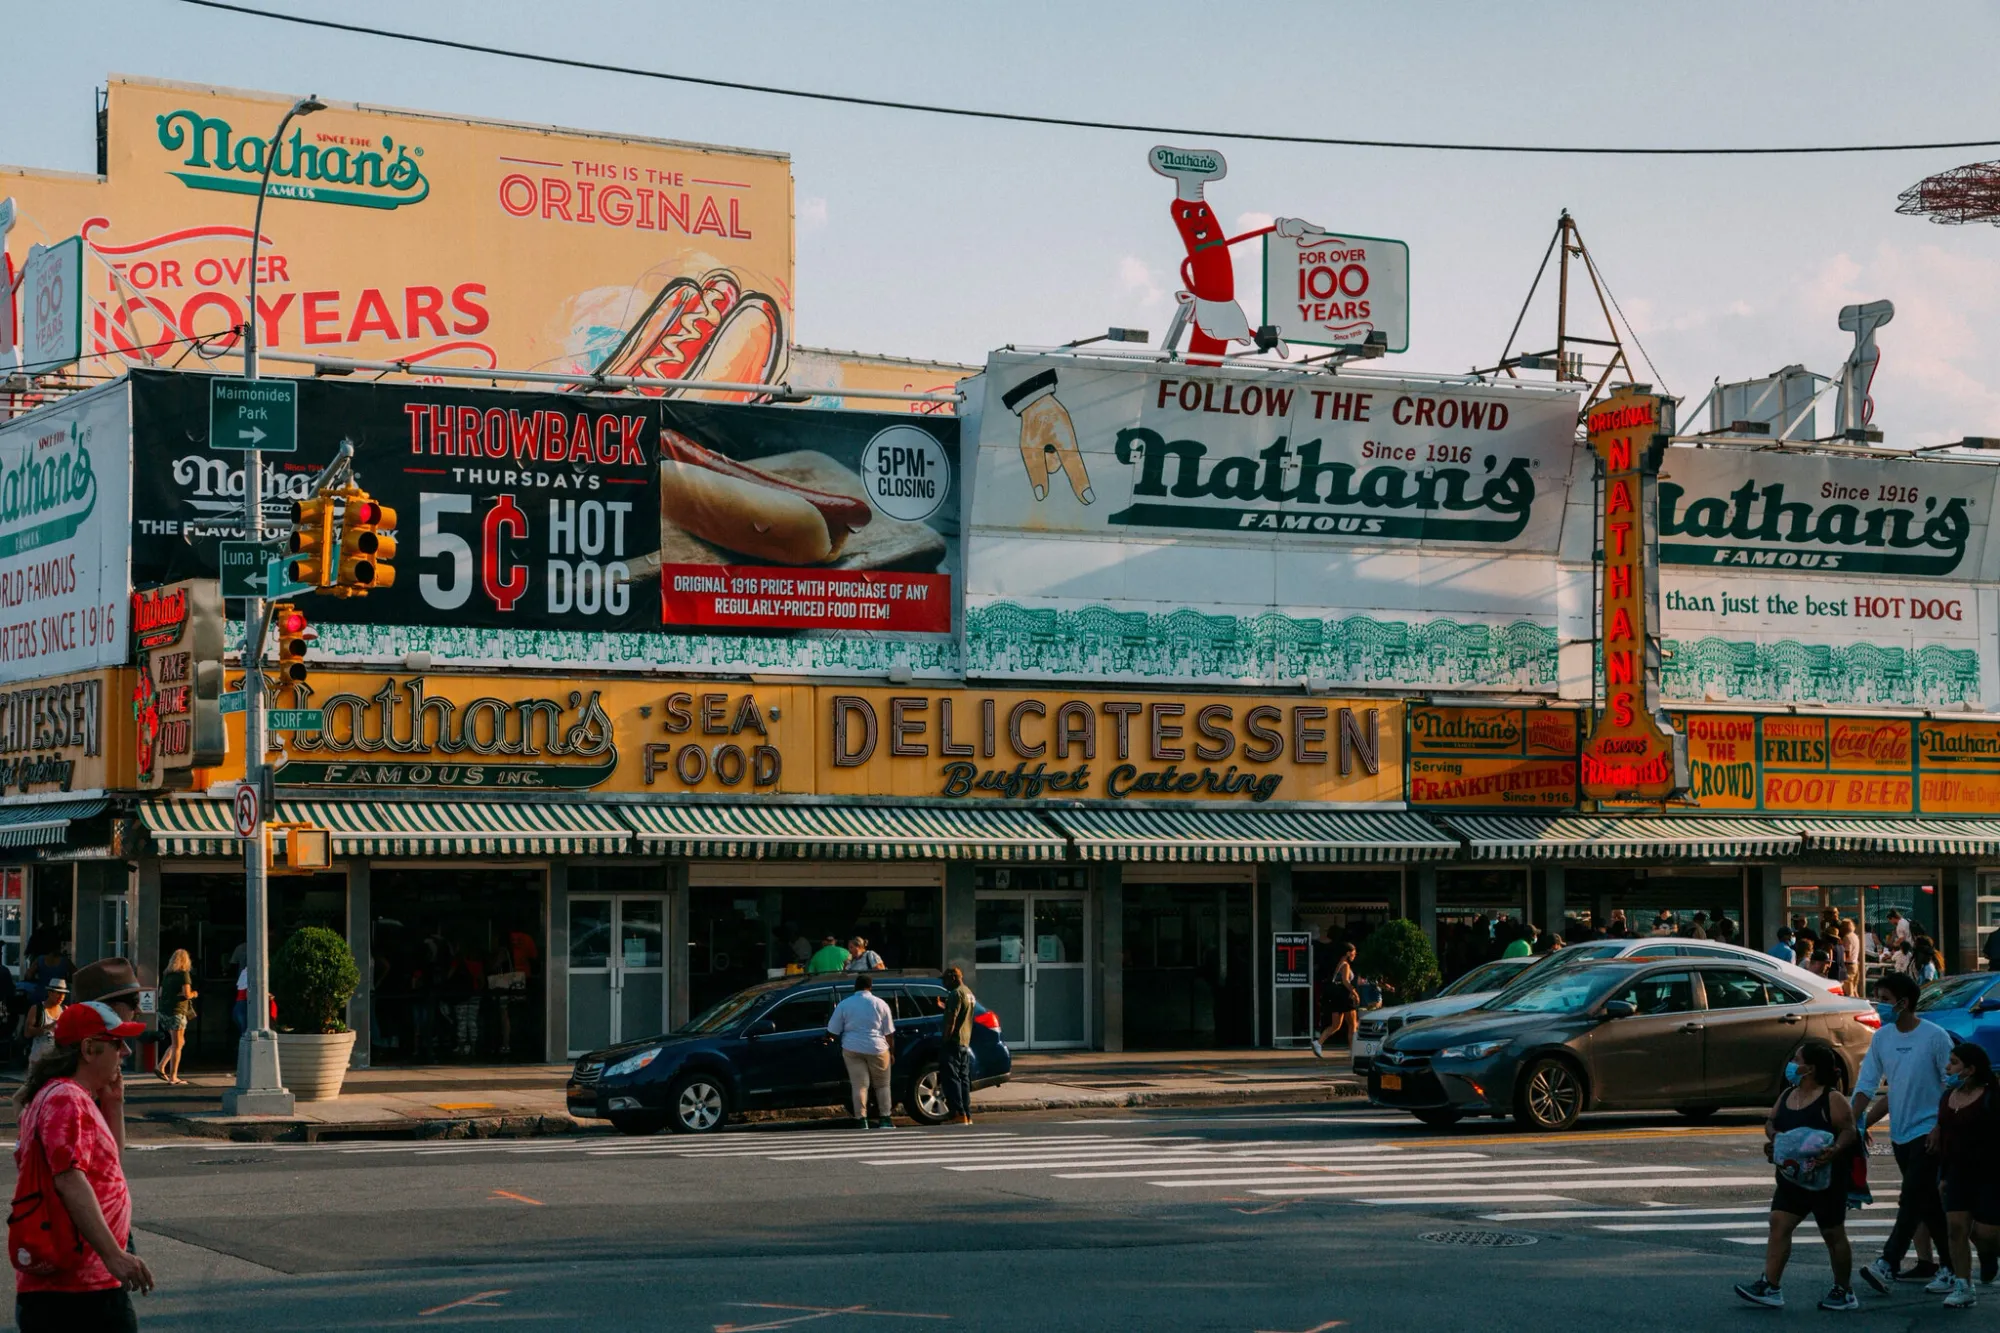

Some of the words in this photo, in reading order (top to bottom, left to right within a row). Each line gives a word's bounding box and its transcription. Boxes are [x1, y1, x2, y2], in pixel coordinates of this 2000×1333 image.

[156, 109, 429, 193] Nathan's
[1157, 150, 1218, 168] Nathan's
[572, 161, 616, 180] THIS
[623, 167, 638, 181] IS
[645, 170, 684, 186] THE
[499, 173, 751, 239] ORIGINAL
[1299, 252, 1326, 264] FOR
[1330, 249, 1366, 262] OVER
[108, 260, 183, 291] FOR
[194, 255, 290, 286] OVER
[1298, 263, 1369, 300] 100
[253, 283, 490, 347] YEARS
[1297, 300, 1371, 321] YEARS
[216, 386, 291, 402] Maimonides
[1157, 379, 1294, 418] FOLLOW
[1314, 390, 1371, 423] THE
[1393, 396, 1509, 432] CROWD
[239, 405, 268, 420] Park
[1588, 401, 1655, 433] ORIGINAL
[404, 403, 647, 465] THROWBACK
[1362, 440, 1416, 462] Since
[1426, 443, 1472, 464] 1916
[0, 421, 91, 525] athan's
[452, 467, 600, 490] THURSDAYS
[1114, 427, 1535, 514] Nathan's
[878, 477, 935, 500] CLOSING
[1821, 482, 1869, 501] Since
[1877, 485, 1919, 503] 1916
[138, 520, 178, 535] THE
[548, 498, 632, 557] HOT
[1238, 513, 1386, 534] FAMOUS
[223, 550, 253, 565] Luna
[1712, 549, 1843, 568] FAMOUS
[0, 565, 23, 608] RLD
[27, 553, 76, 602] FAMOUS
[547, 560, 630, 616] DOG
[674, 576, 728, 593] ORIGINAL
[730, 577, 758, 594] 1916
[760, 578, 794, 596] PRICE
[797, 579, 825, 597] WITH
[828, 581, 887, 599] PURCHASE
[889, 583, 904, 599] OF
[906, 584, 928, 601] ANY
[715, 597, 825, 617] REGULARLY-PRICED
[827, 602, 857, 618] FOOD
[859, 603, 890, 619] ITEM!
[1666, 590, 1715, 612] than
[1720, 591, 1760, 616] just
[1766, 594, 1798, 615] the
[1805, 595, 1848, 617] best
[1854, 596, 1905, 619] HOT
[1910, 598, 1962, 621] DOG
[41, 610, 76, 656] SINCE
[81, 604, 115, 647] 1916
[158, 652, 188, 682] TAKE
[158, 686, 189, 714] HOME
[273, 712, 303, 728] SURF
[307, 713, 317, 721] AV
[665, 692, 768, 736] SEA
[1413, 711, 1520, 740] Nathan's
[158, 720, 189, 755] FOOD
[831, 694, 1380, 775] DELICATESSEN
[1688, 720, 1753, 741] FOLLOW
[1764, 723, 1802, 737] FRESH
[1805, 724, 1824, 737] CUT
[644, 743, 783, 786] FOOD
[1706, 743, 1736, 761] THE
[1764, 740, 1825, 763] FRIES
[324, 764, 485, 784] FAMOUS
[943, 761, 1091, 799] Buffet
[1107, 763, 1283, 801] Catering
[1413, 761, 1462, 775] Serving
[1689, 759, 1754, 800] CROWD
[1411, 763, 1576, 801] FRANKFURTERS
[1765, 778, 1840, 804] ROOT
[1847, 780, 1911, 805] BEER
[1503, 791, 1536, 803] Since
[1276, 936, 1293, 944] Which
[1294, 936, 1308, 945] Way?
